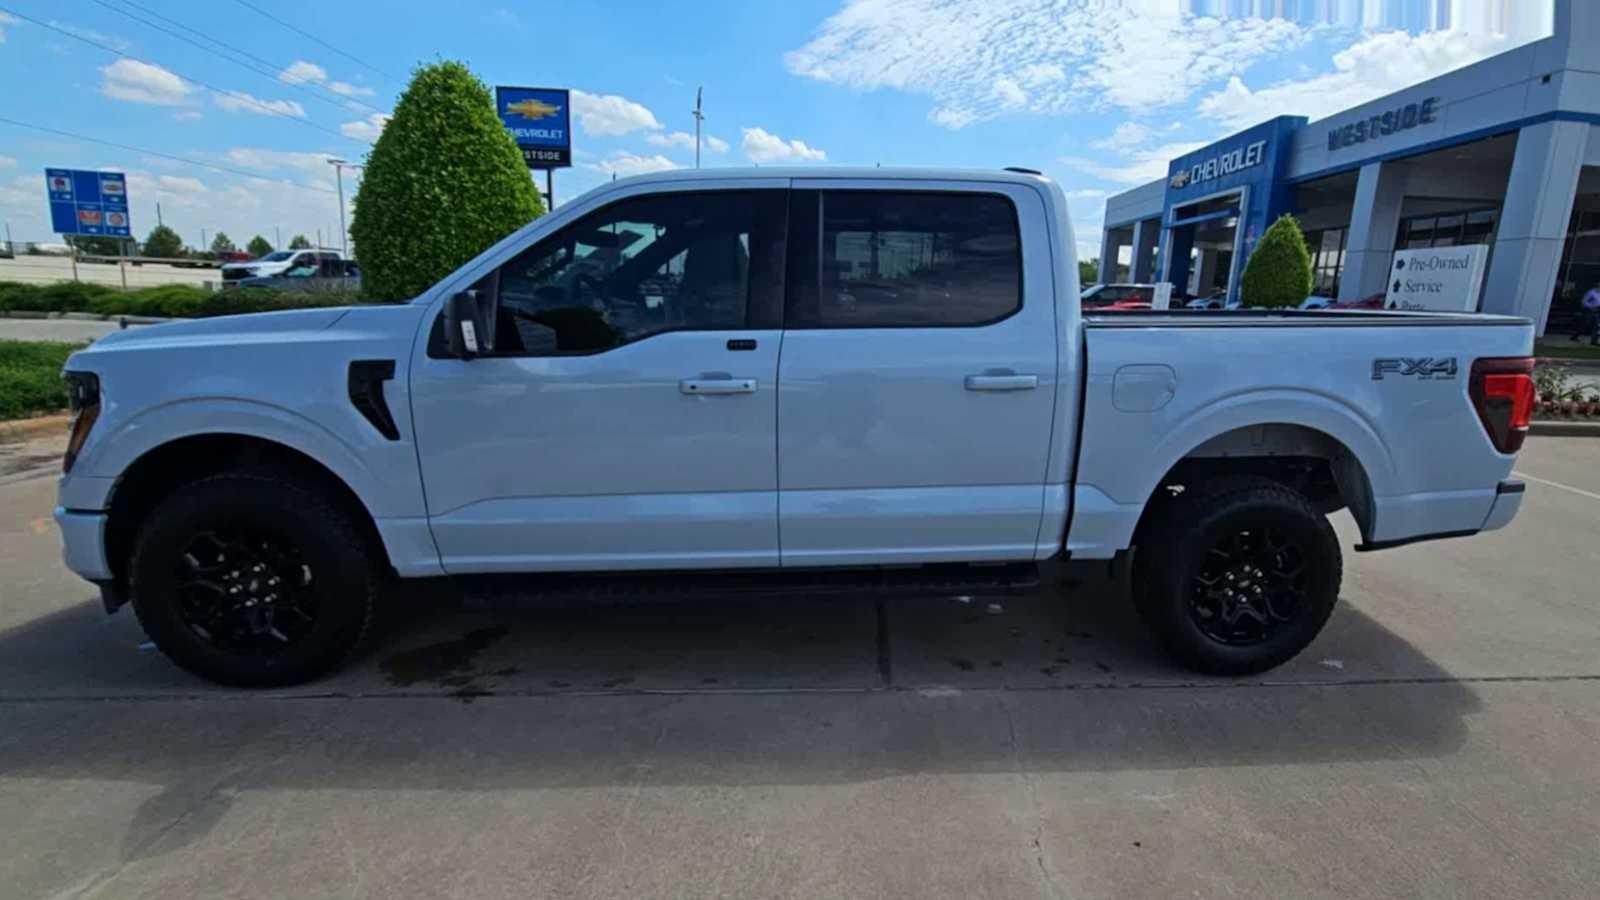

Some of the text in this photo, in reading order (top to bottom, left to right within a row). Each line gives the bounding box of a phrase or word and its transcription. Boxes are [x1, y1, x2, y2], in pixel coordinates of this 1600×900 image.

[1328, 97, 1439, 150] WESTSIDE
[524, 150, 561, 160] STSIDE
[1191, 140, 1267, 184] CHEVROLET
[1409, 254, 1469, 271] Pre-Owned
[1404, 280, 1443, 293] Service
[1371, 357, 1458, 380] FX4
